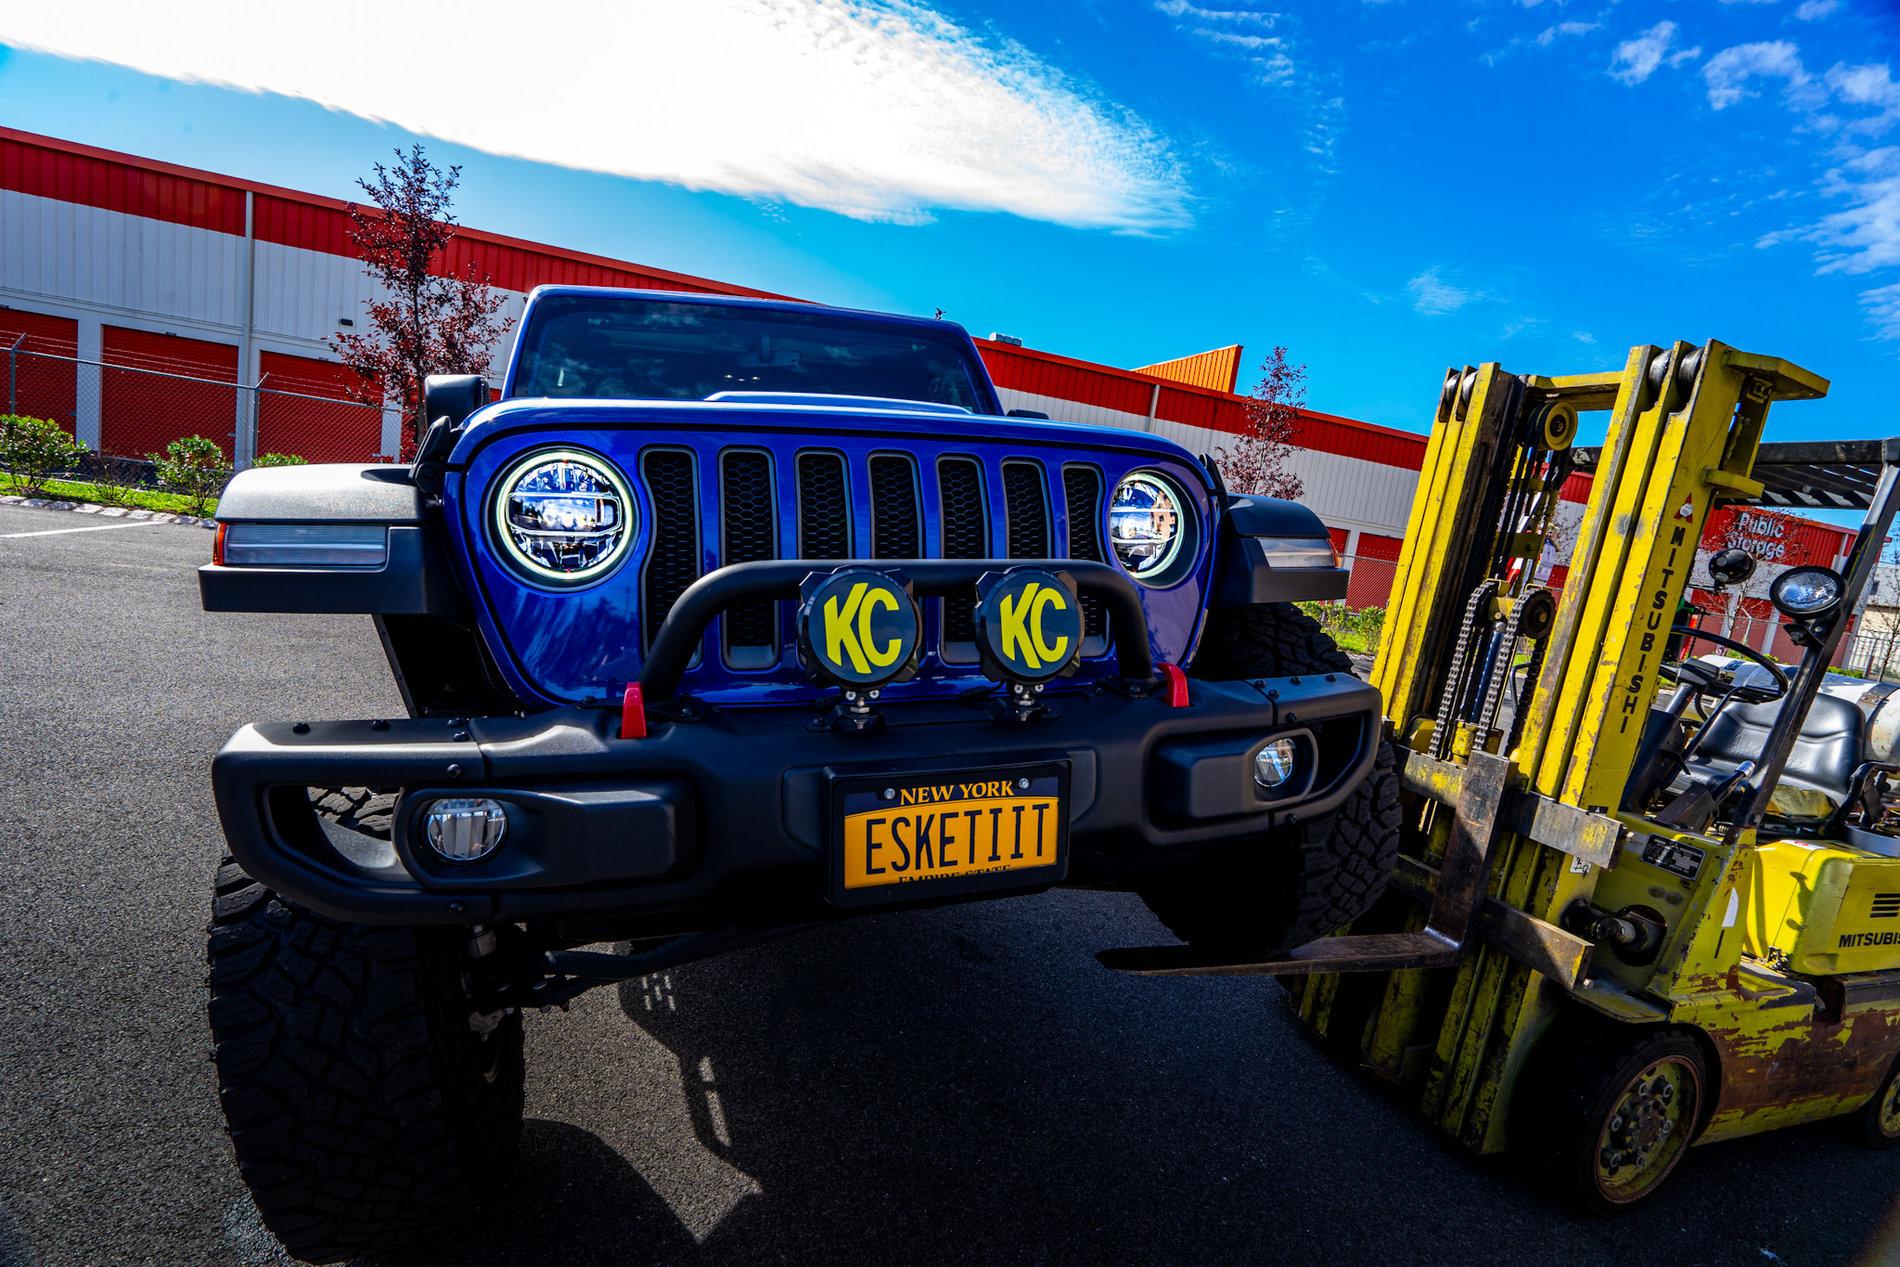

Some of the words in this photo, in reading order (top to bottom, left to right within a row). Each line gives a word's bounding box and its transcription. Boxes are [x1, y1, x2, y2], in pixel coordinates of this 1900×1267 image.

[1728, 531, 1785, 560] Storage
[1738, 512, 1785, 538] Public
[824, 582, 902, 674] KC
[1000, 582, 1069, 669] KC
[1620, 526, 1685, 734] MITSUBISHI
[900, 784, 954, 806] NEW
[960, 780, 1015, 799] YORK
[866, 803, 1050, 875] ESKETIIT
[1838, 932, 1900, 948] MITSUBI
